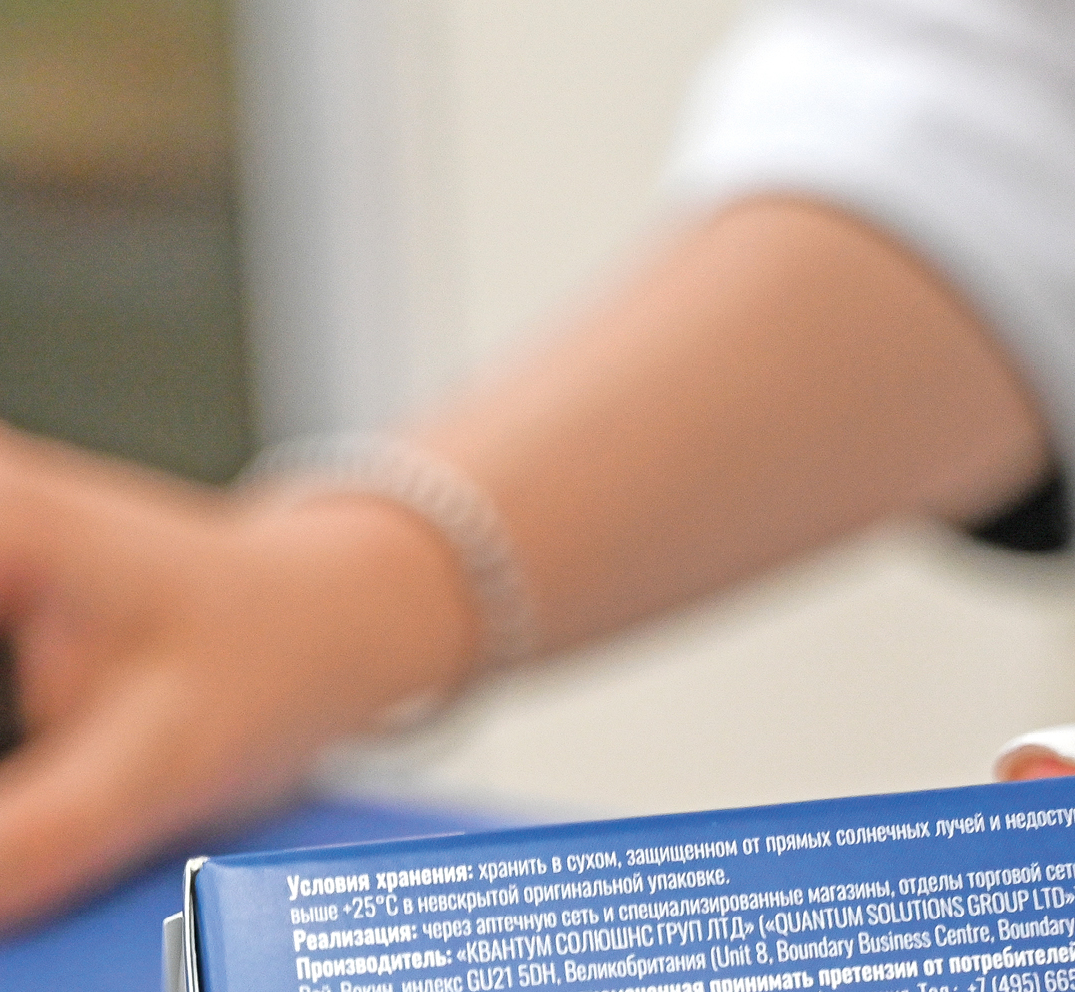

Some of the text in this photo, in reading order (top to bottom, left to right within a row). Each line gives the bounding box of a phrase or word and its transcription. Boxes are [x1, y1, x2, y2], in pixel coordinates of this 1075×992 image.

[286, 806, 1075, 902] Условия хранения: хранить в сухом, защищенном от прямых солнечных лучей и недосту
[290, 904, 339, 925] выше
[402, 897, 415, 915] в
[417, 883, 520, 914] невскрытой
[523, 871, 645, 907] оригинальной
[646, 867, 731, 896] упаковке.
[292, 861, 1075, 953] Реализация: через аптечную сеть и специализированные магазины, отделы торговой сет
[295, 949, 453, 984] Производитель:
[456, 933, 554, 965] «КВАНТУМ
[555, 923, 655, 956] СОЛЮШНС
[656, 918, 703, 947] ГРУП
[706, 914, 755, 943] ЛТД»
[758, 904, 865, 940] («QUANTUM
[865, 895, 966, 926] SOLUTIONS
[966, 889, 1030, 917] GROUP
[466, 965, 513, 992] GU21
[517, 960, 562, 988] 5DH,
[563, 951, 707, 983] Великобритания
[710, 943, 753, 972] (Unit
[755, 940, 774, 966] 8,
[775, 935, 855, 963] Boundary
[857, 930, 932, 955] Business
[934, 922, 995, 948] Centre,
[996, 915, 1075, 941] Boundary
[818, 959, 919, 991] претензии
[922, 957, 944, 977] от
